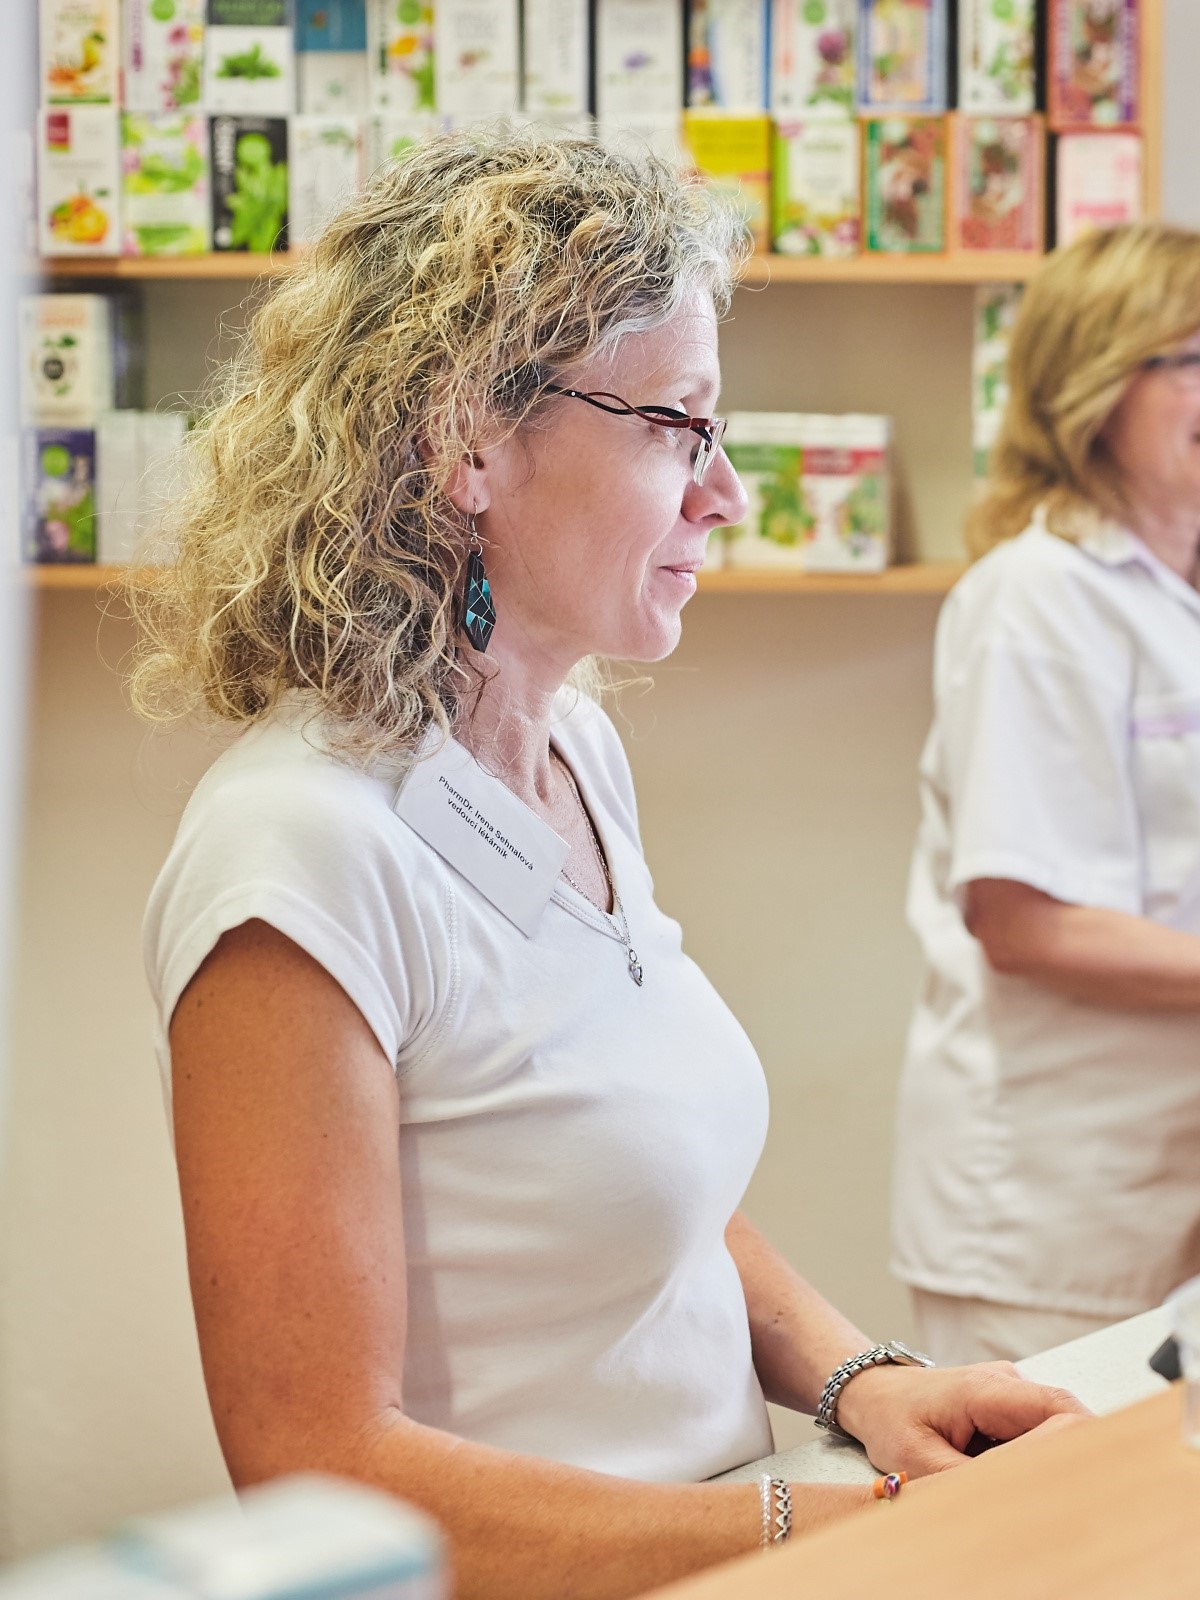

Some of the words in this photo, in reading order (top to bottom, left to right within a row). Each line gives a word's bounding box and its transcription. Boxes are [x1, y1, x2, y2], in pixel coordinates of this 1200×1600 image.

[438, 776, 474, 813] PharmDr.
[474, 810, 494, 832] Irena
[494, 830, 534, 871] Sehnalová
[447, 798, 478, 829] vedoucí
